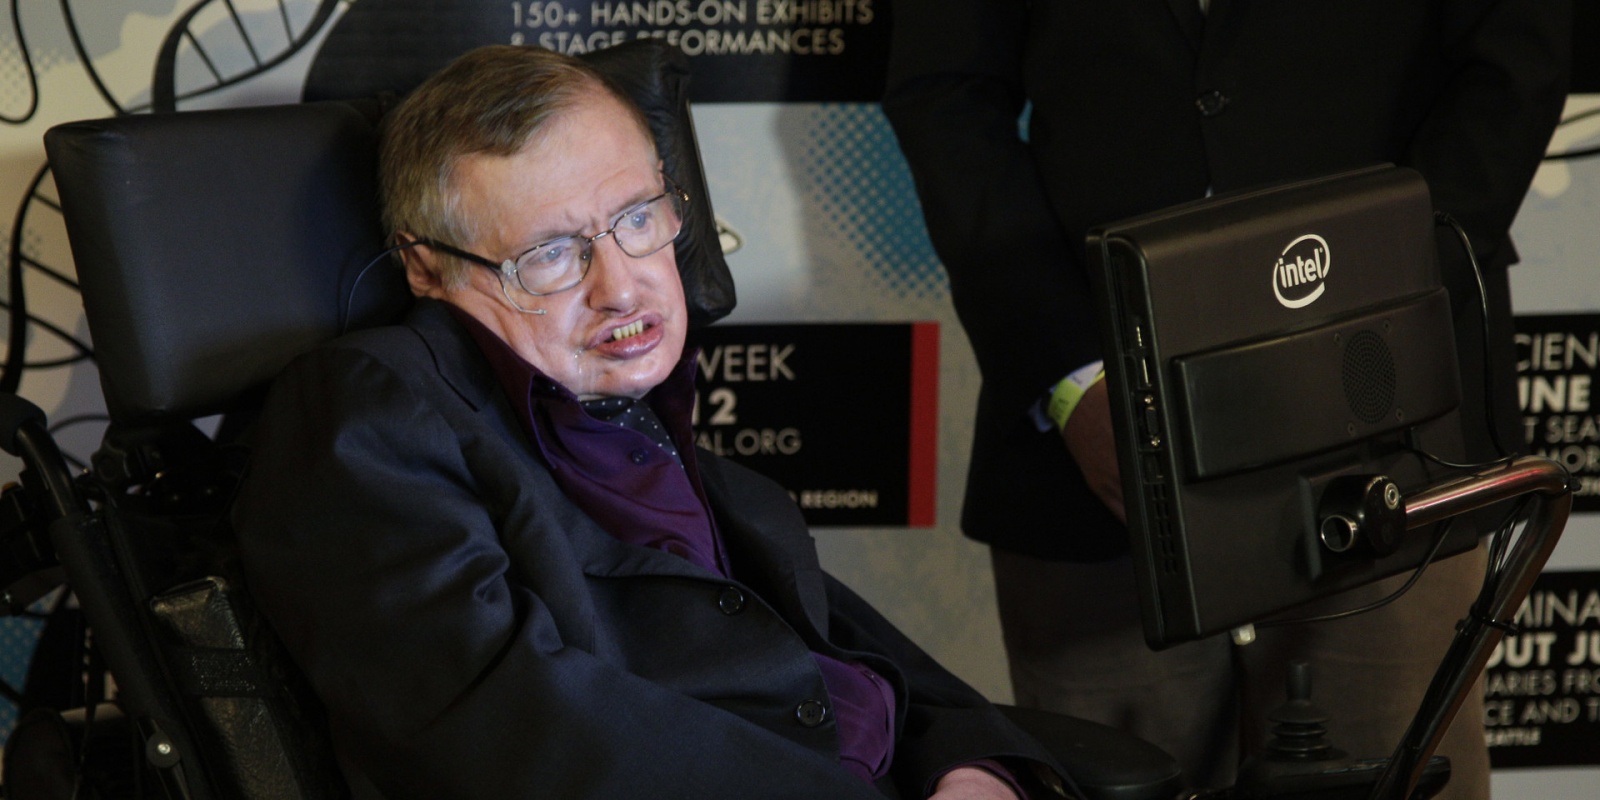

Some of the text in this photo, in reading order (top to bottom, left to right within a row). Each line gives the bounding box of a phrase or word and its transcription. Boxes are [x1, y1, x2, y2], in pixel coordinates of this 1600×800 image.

[511, 0, 874, 27] 150+ HANDS-ON EXHIBITS
[539, 31, 625, 57] STAGE
[1279, 248, 1322, 288] intel
[1514, 332, 1600, 372] CIEN
[693, 427, 802, 456] AL.ORG
[801, 489, 879, 509] REGION
[1486, 669, 1556, 696] ARIES
[1520, 697, 1581, 724] AND
